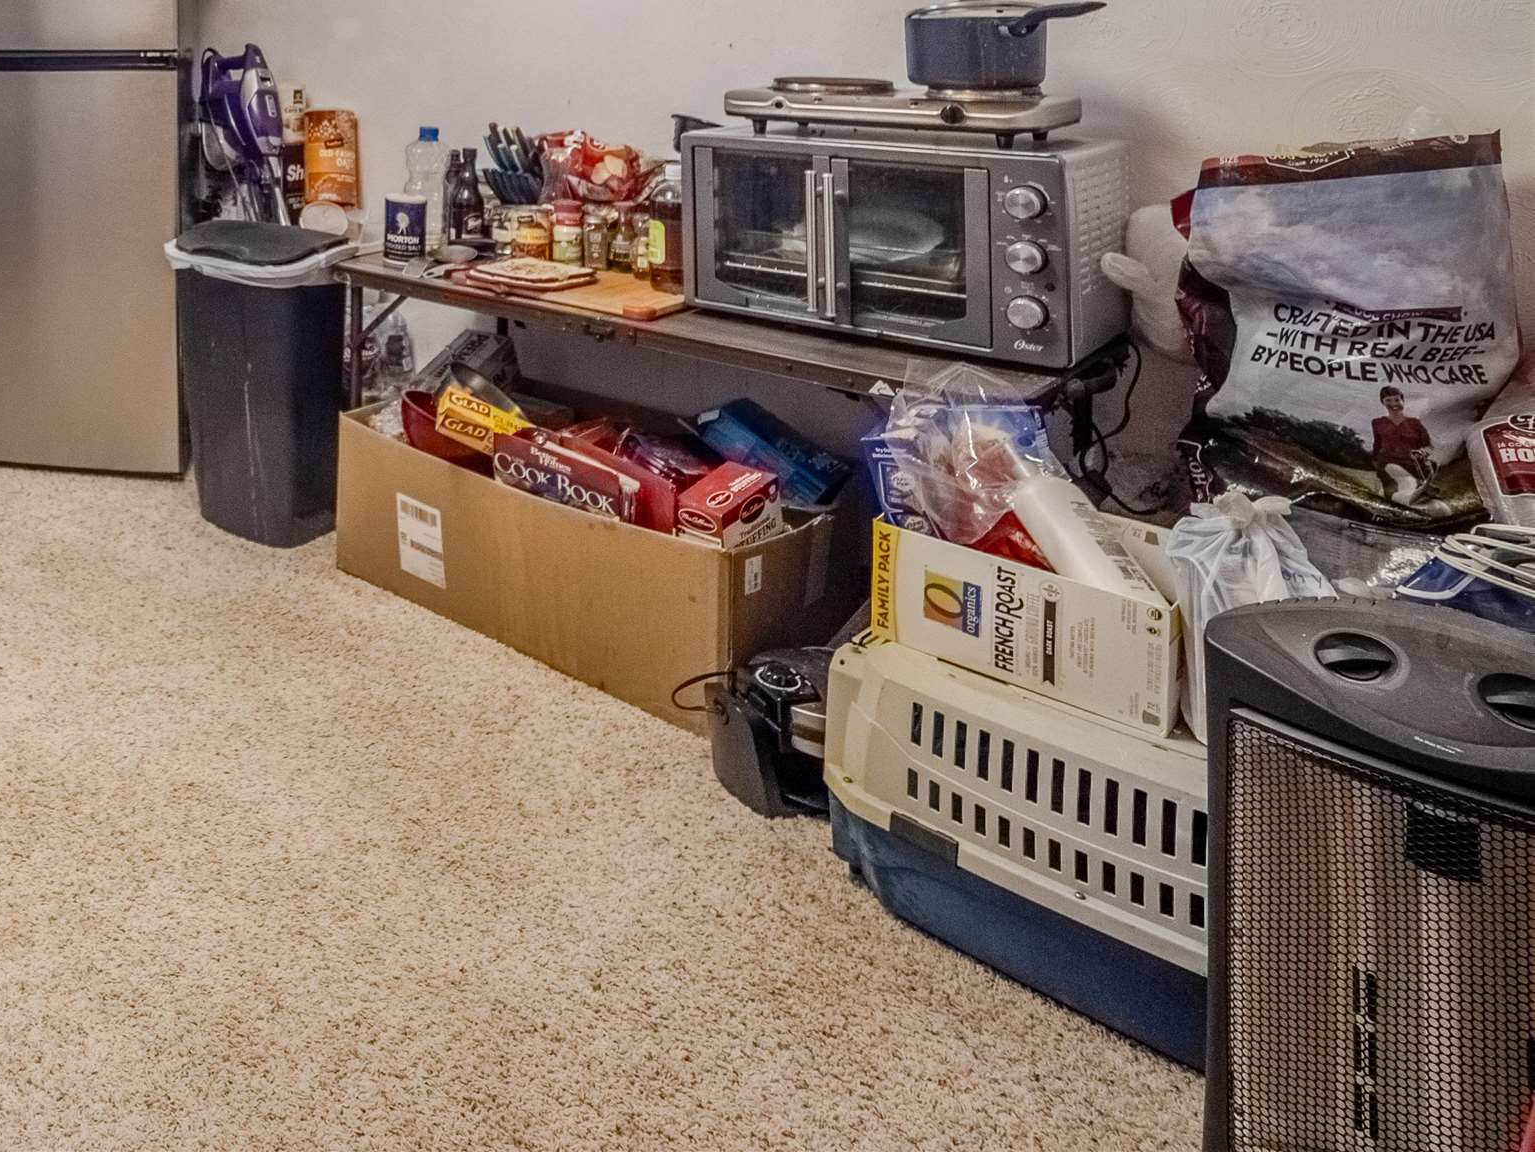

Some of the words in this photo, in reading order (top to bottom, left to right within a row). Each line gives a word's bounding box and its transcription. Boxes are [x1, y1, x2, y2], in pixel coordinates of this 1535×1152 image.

[386, 233, 420, 244] MORTON
[1273, 303, 1369, 338] CRAFTED
[1377, 321, 1411, 339] IN
[1417, 321, 1463, 344] THE
[1465, 321, 1496, 341] USA
[1013, 339, 1044, 352] Oster
[1250, 344, 1277, 365] BY
[1275, 350, 1379, 383] PEOPLE
[1381, 362, 1428, 385] WHO
[1431, 363, 1489, 385] CARE
[1347, 340, 1417, 361] REAL
[450, 394, 489, 414] GLAD
[444, 418, 486, 437] GLAD
[1498, 447, 1535, 464] HO
[878, 531, 891, 571] PACK
[877, 571, 891, 629] FAMILY
[965, 586, 979, 634] organics
[995, 566, 1024, 619] ROAST
[994, 616, 1015, 673] FRENCH
